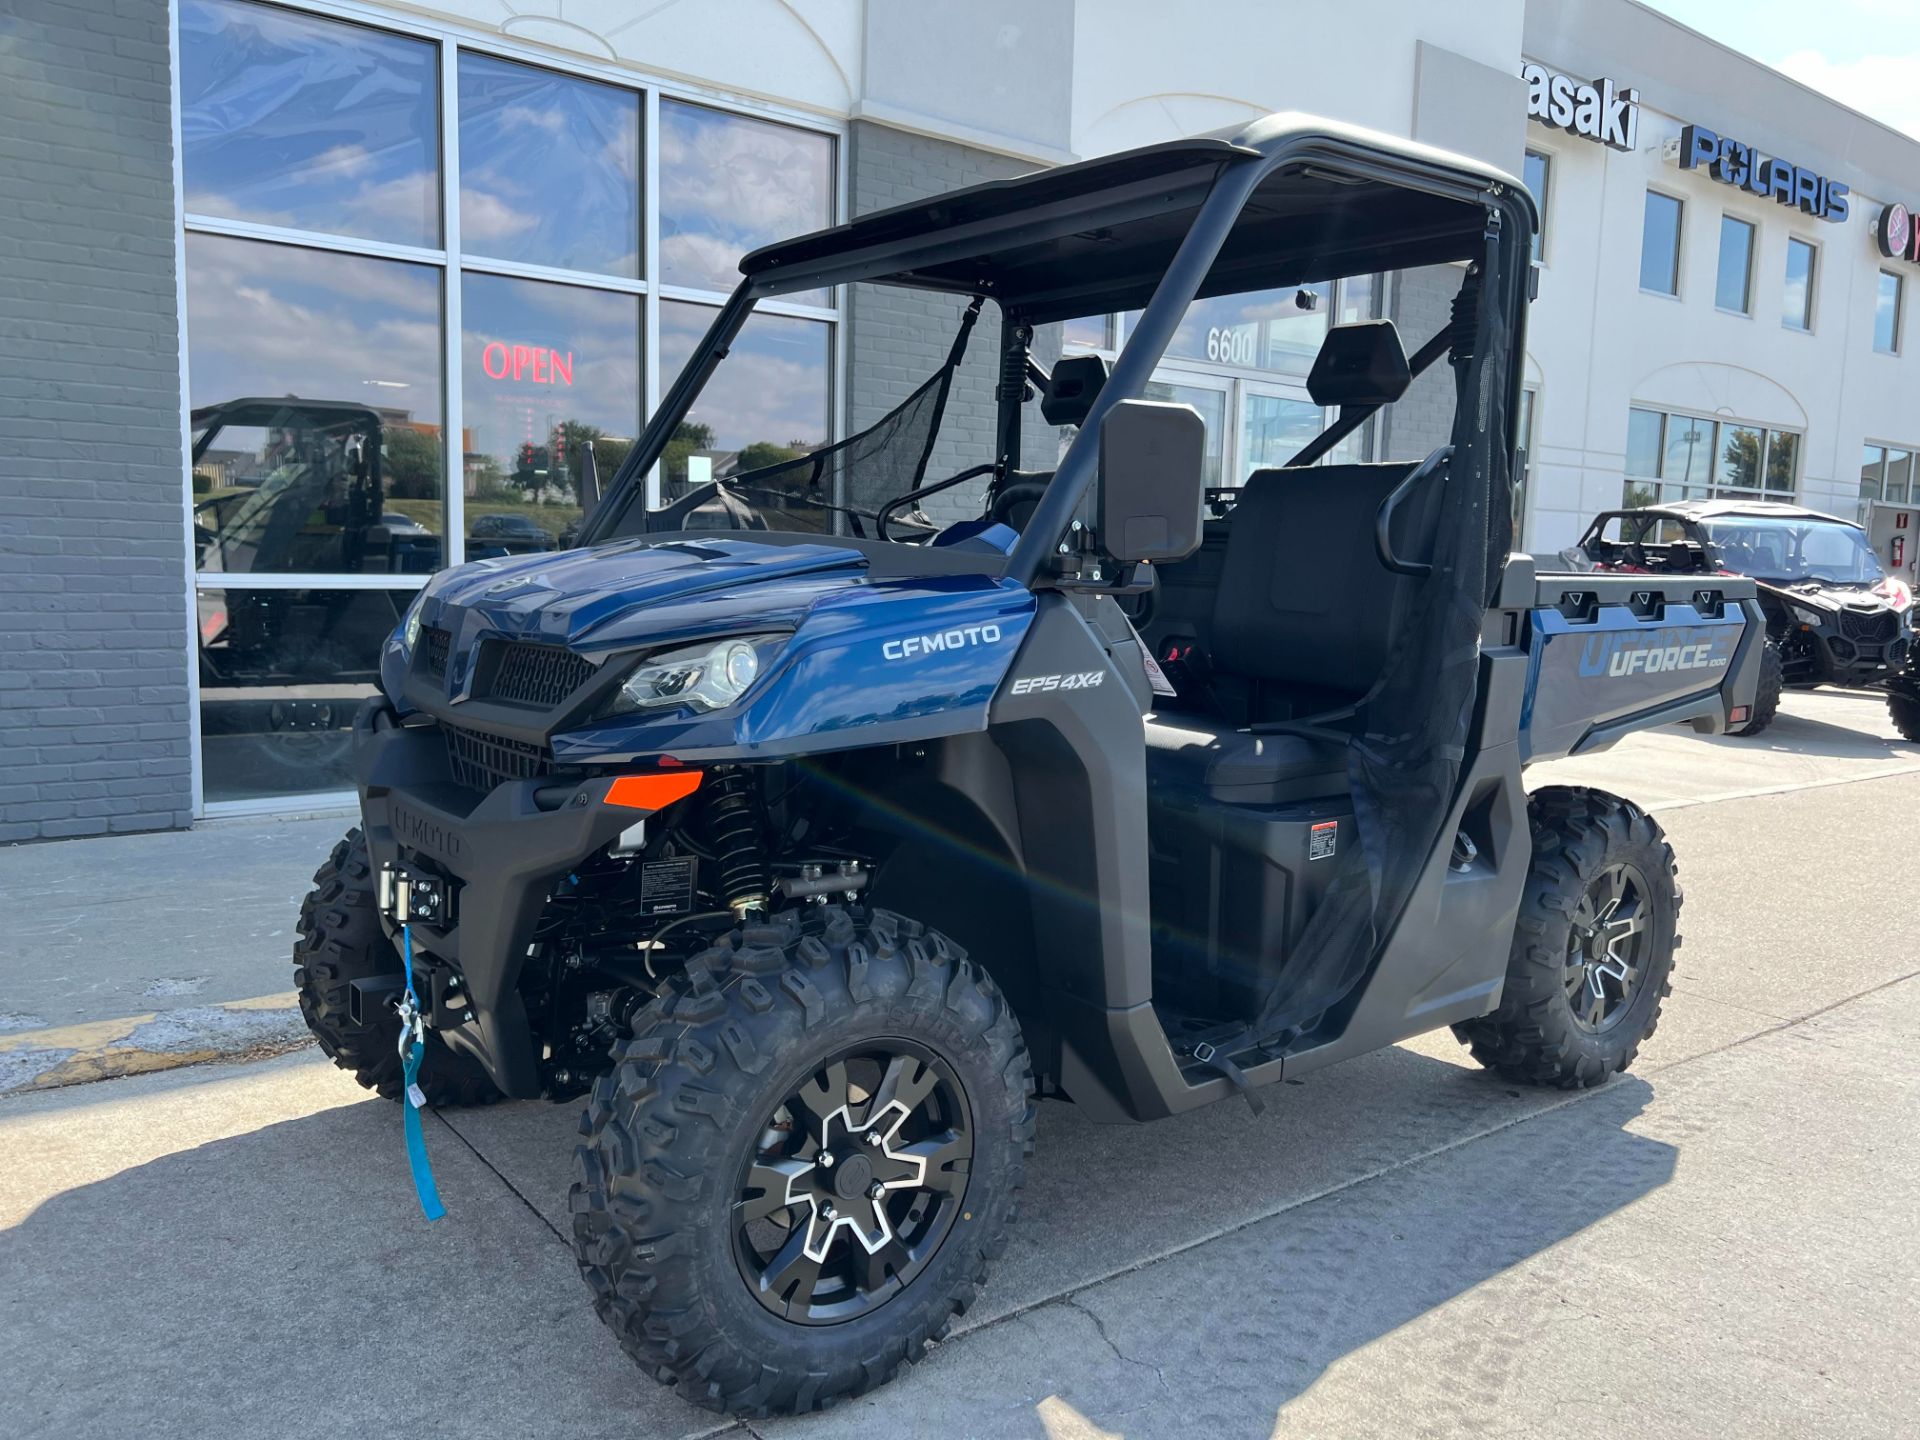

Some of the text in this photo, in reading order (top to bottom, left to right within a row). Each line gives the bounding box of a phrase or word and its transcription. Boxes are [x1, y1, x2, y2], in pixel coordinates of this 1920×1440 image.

[1521, 61, 1640, 151] asaki
[1682, 124, 1849, 223] POLARIS
[483, 341, 573, 386] OPEN
[1208, 327, 1251, 363] 6600
[882, 624, 1001, 661] CFMOTO
[1608, 643, 1713, 677] UFORCE
